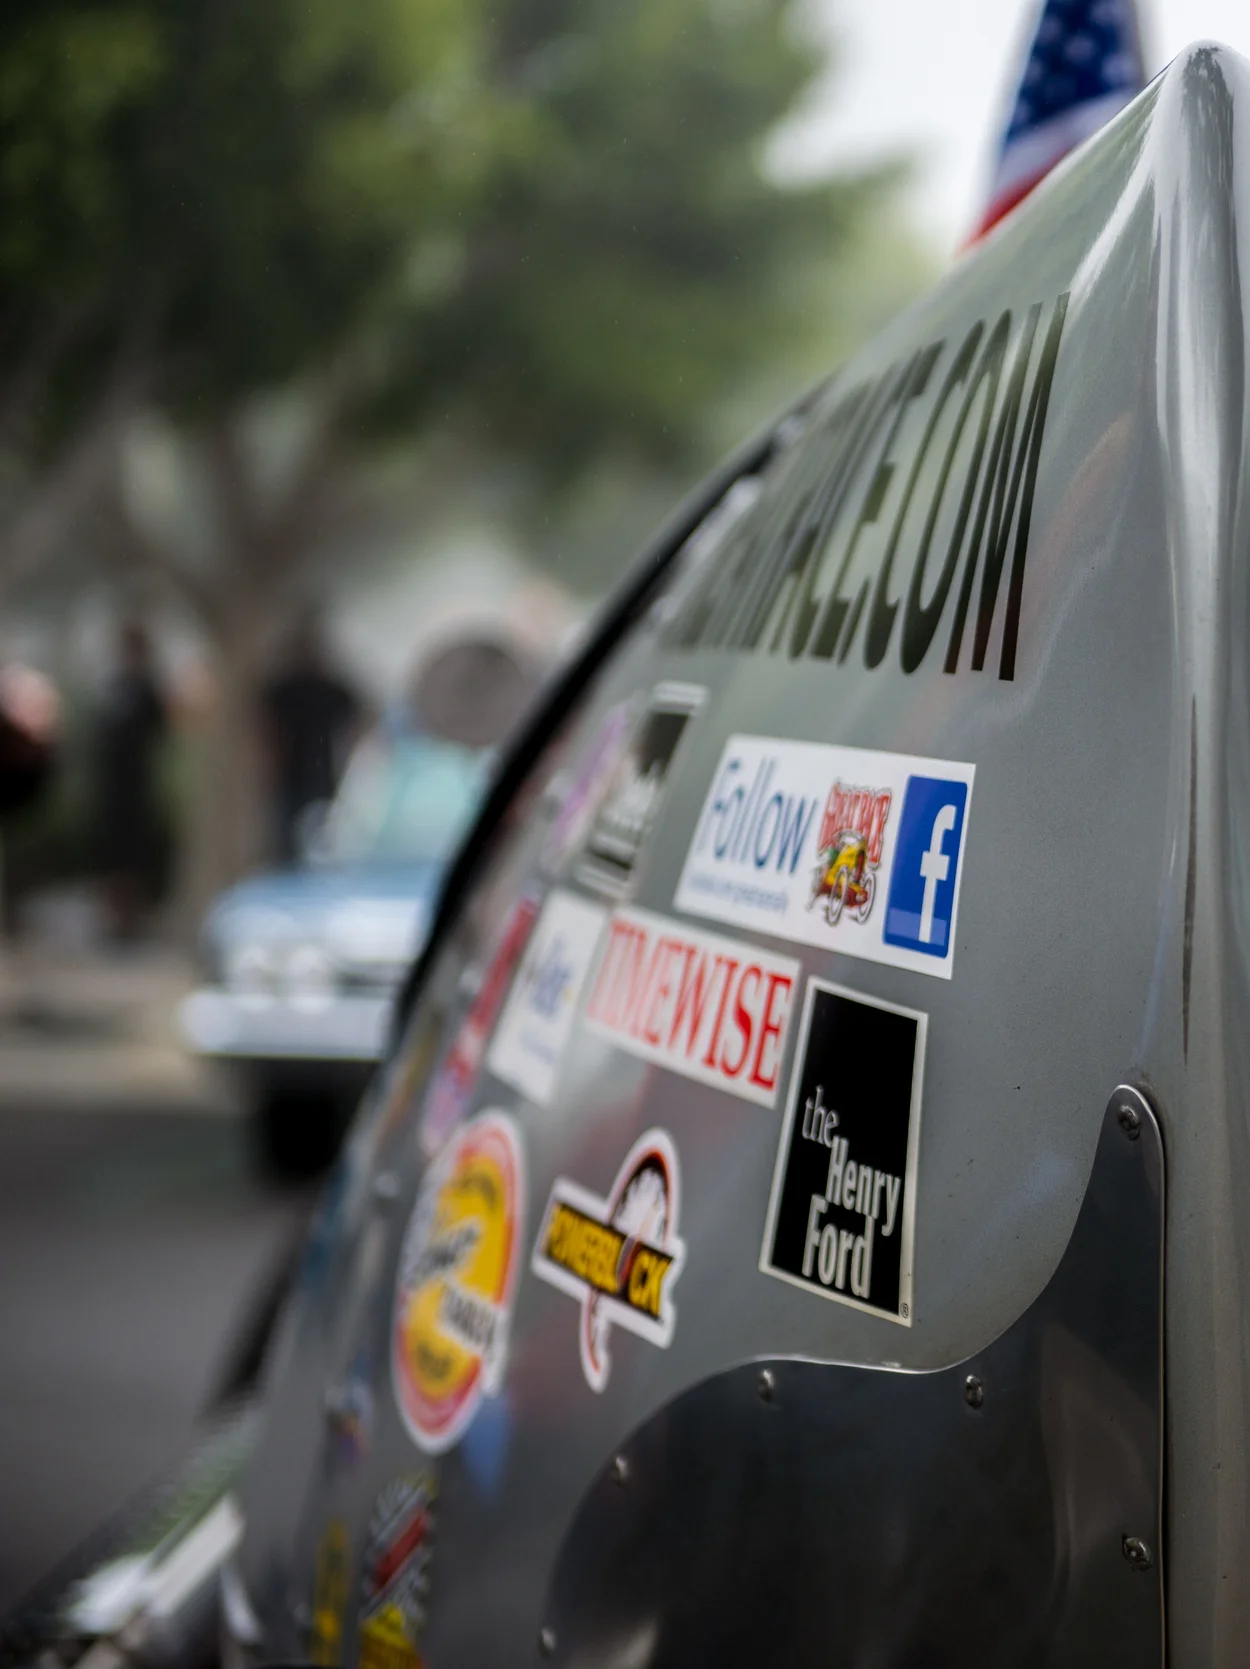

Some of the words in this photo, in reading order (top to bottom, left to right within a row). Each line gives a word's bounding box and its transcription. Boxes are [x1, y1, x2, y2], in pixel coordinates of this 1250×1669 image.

[697, 755, 821, 877] Follow
[588, 919, 793, 1092] TIMEWISE
[802, 1084, 839, 1148] the
[826, 1135, 901, 1237] Henry
[802, 1193, 875, 1299] Ford
